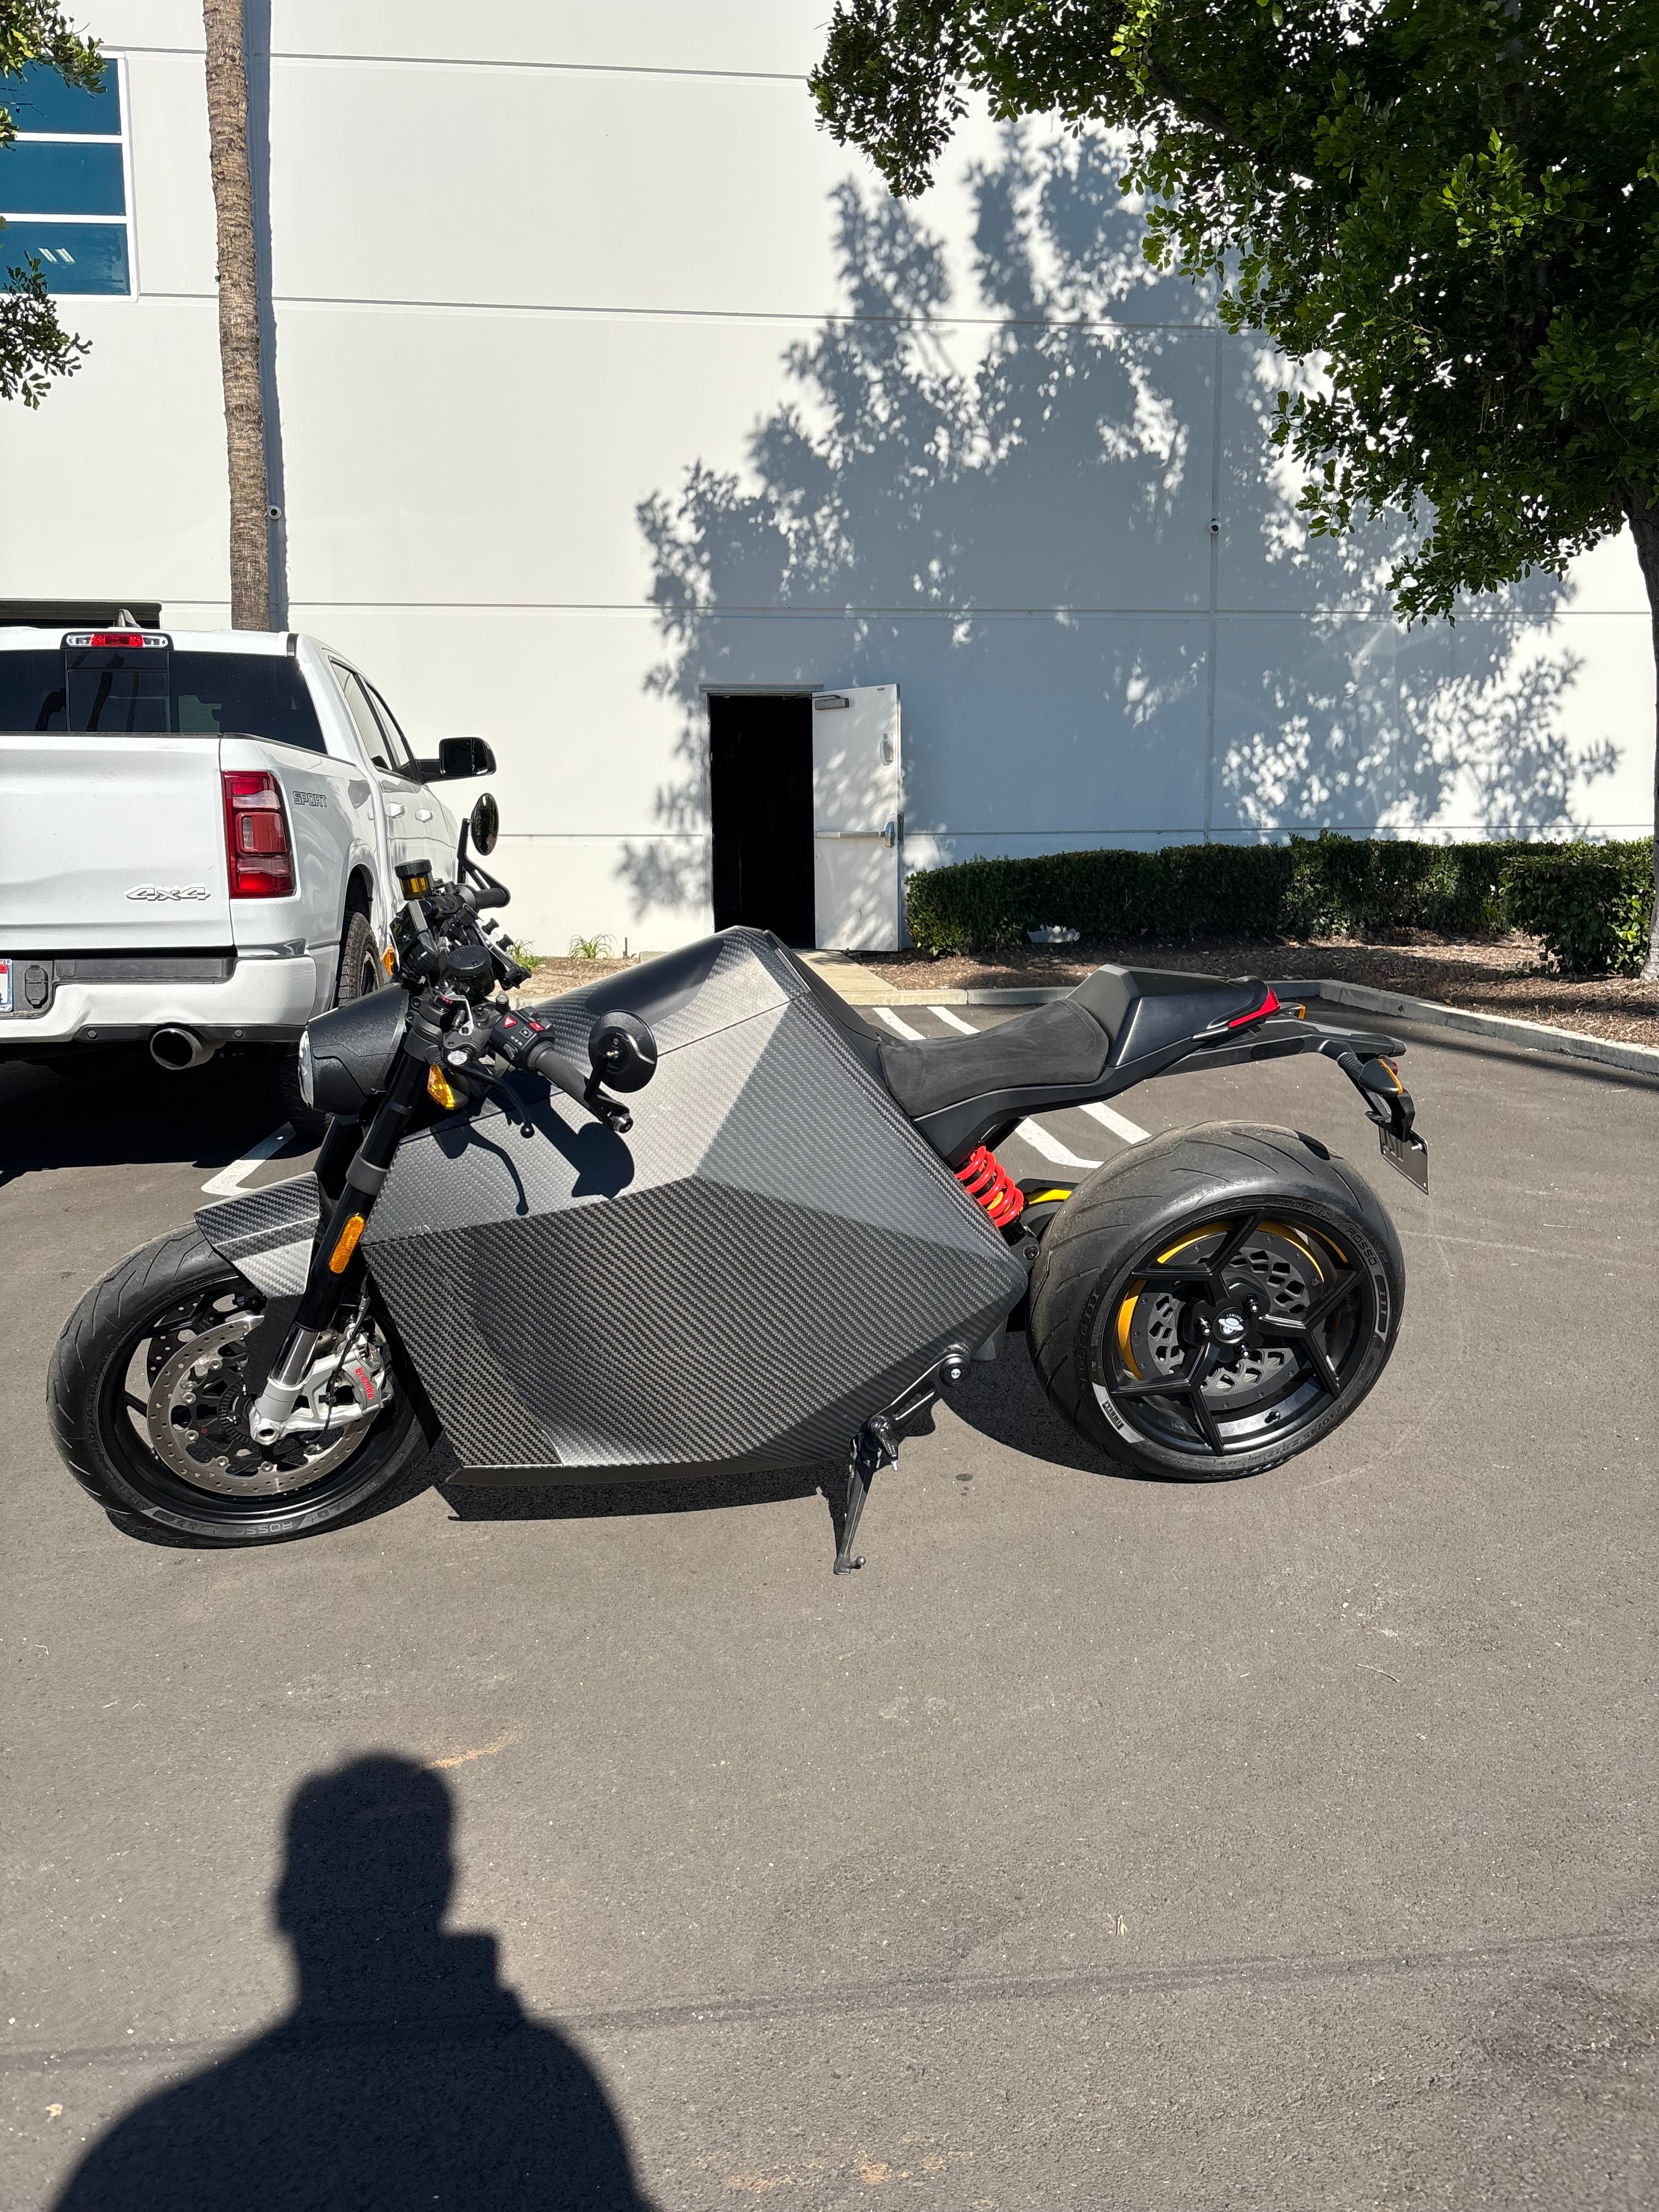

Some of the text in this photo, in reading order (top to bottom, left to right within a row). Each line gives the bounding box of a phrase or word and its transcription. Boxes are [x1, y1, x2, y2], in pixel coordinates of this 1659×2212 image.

[293, 791, 328, 808] SPORT
[1346, 1228, 1378, 1266] ROSSO
[355, 1367, 374, 1400] brembo
[1102, 1400, 1125, 1430] PIRELLI
[234, 1521, 293, 1535] ROSSO
